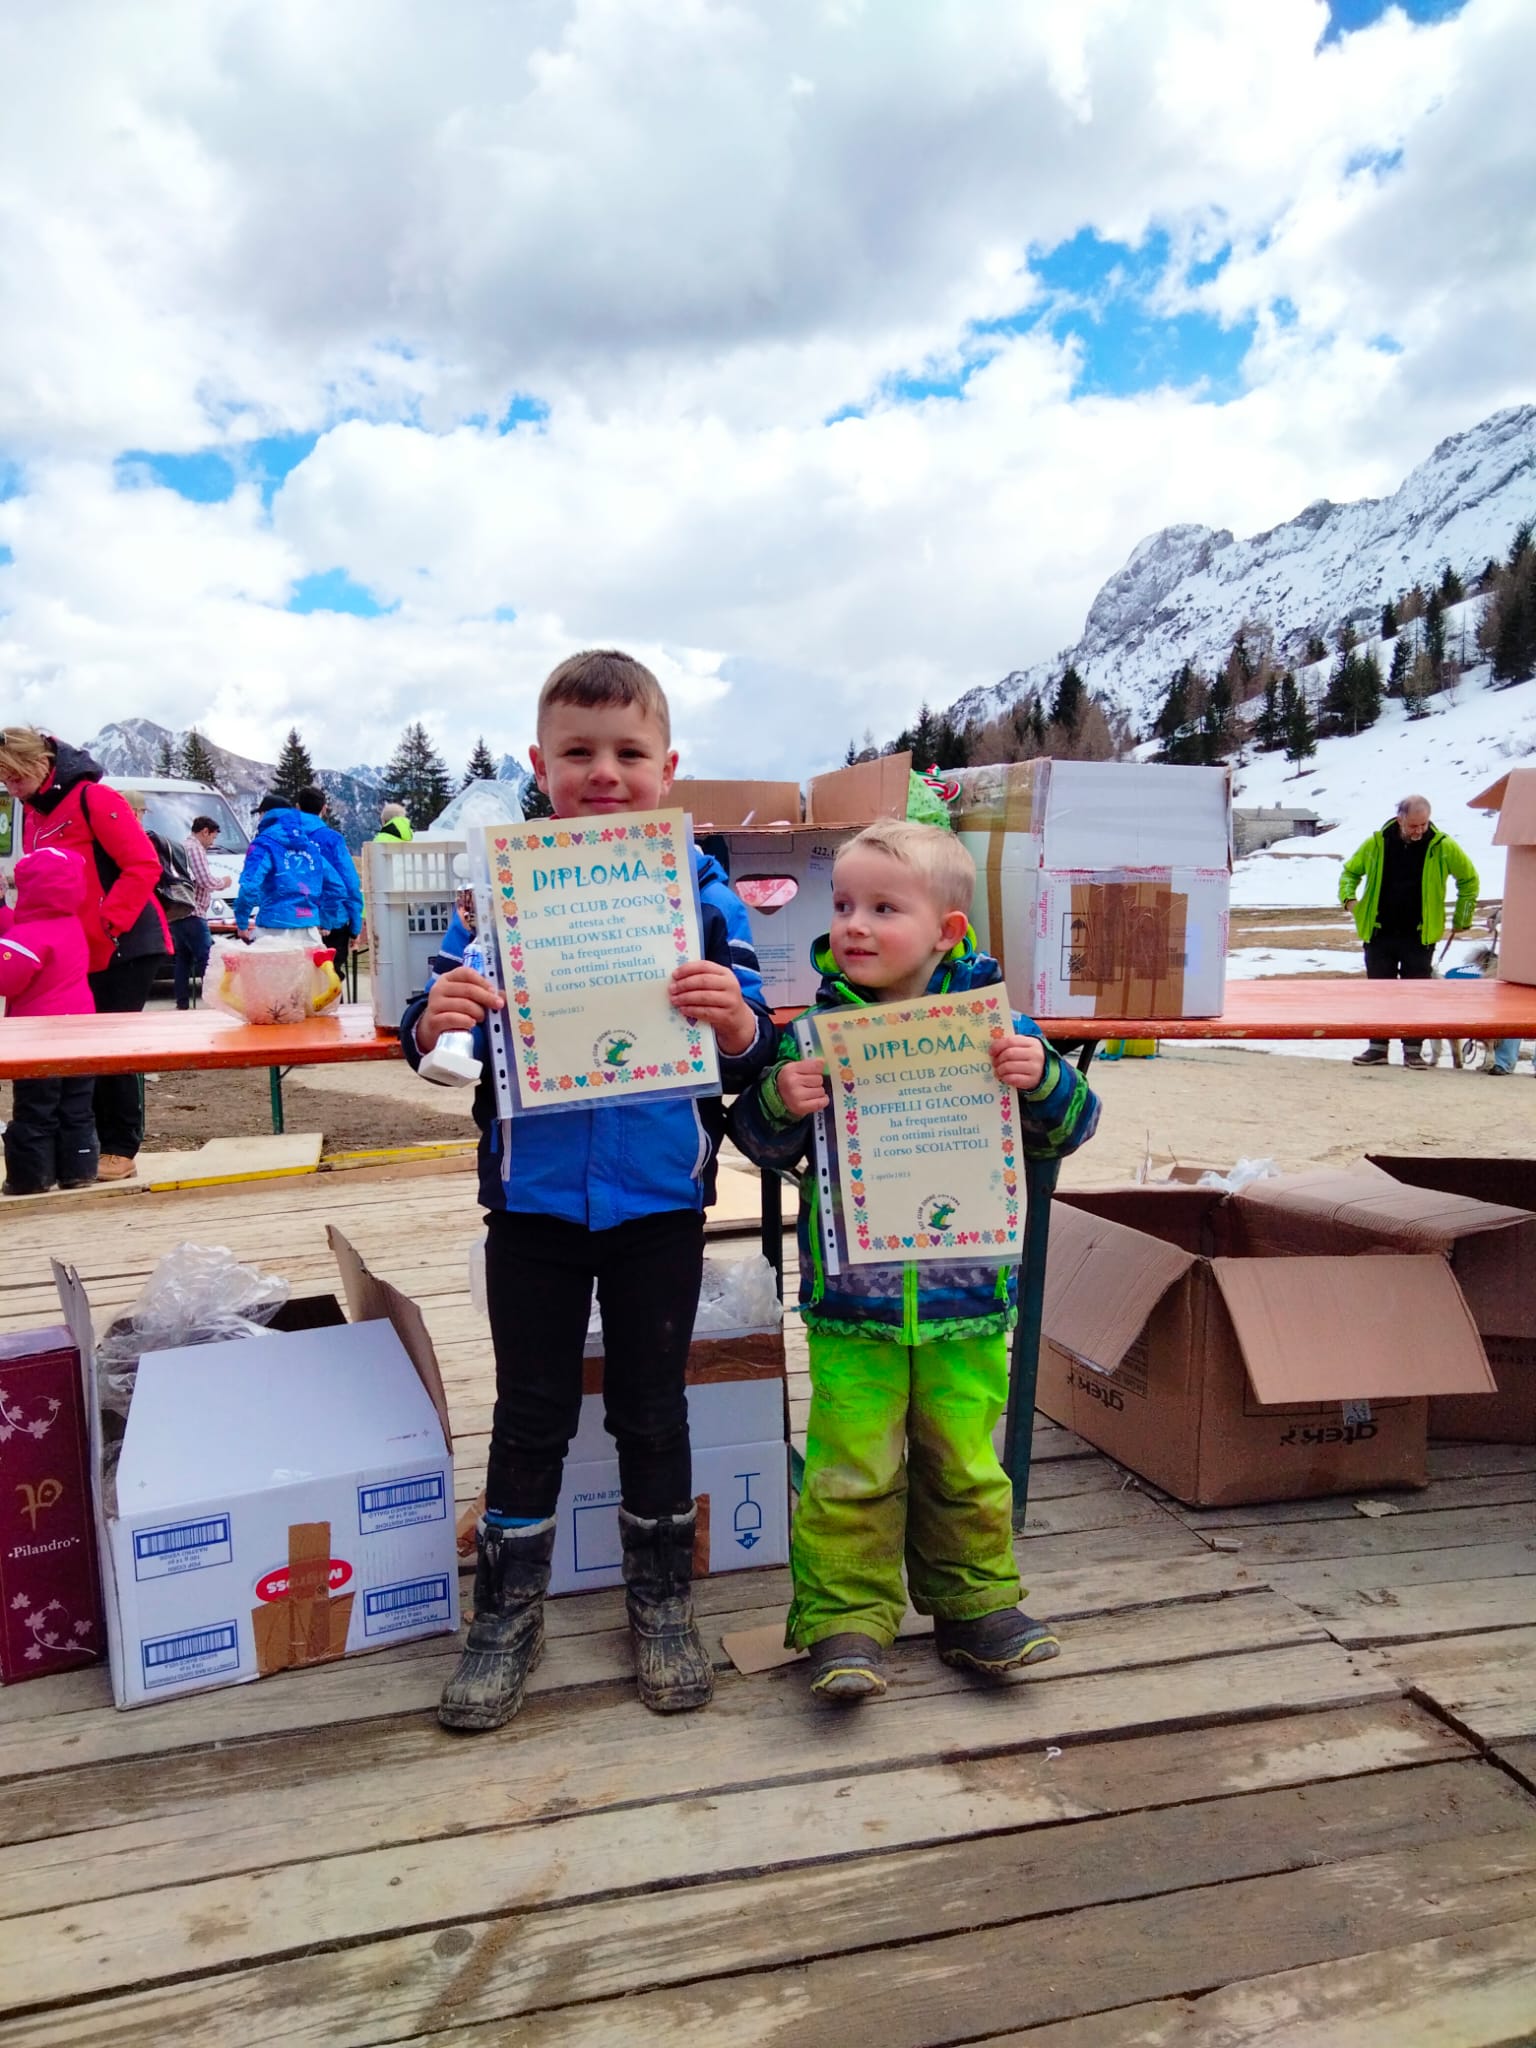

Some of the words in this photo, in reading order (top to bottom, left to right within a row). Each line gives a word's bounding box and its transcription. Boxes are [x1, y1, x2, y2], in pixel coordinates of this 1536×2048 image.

[533, 859, 650, 892] DIPLOMA
[523, 910, 538, 920] Lo
[543, 904, 566, 918] SCI
[570, 900, 608, 914] CLUB
[612, 893, 666, 910] ZOGNO
[568, 917, 604, 930] attesta
[607, 915, 626, 926] che
[524, 929, 623, 950] CHMIELOWSKI
[625, 923, 673, 938] CESARE
[560, 951, 574, 961] ha
[577, 944, 642, 960] frequentato
[551, 967, 571, 977] con
[574, 960, 609, 974] ottimi
[612, 954, 656, 970] risultati
[544, 982, 553, 993] il
[555, 980, 586, 992] corso
[589, 968, 666, 988] SCOIATTOLI
[863, 1033, 976, 1061] DIPLOMA
[857, 1077, 870, 1086] Lo
[875, 1072, 896, 1085] SCI
[900, 1068, 936, 1081] CLUB
[939, 1062, 992, 1077] ZOGNO
[898, 1085, 931, 1097] attesta
[934, 1082, 952, 1093] che
[861, 1100, 922, 1116] BOFFELLI
[925, 1093, 995, 1110] GIACOMO
[890, 1118, 902, 1128] ha
[905, 1113, 968, 1127] frequentato
[879, 1135, 899, 1143] con
[902, 1128, 935, 1141] ottimi
[938, 1124, 980, 1138] risultati
[873, 1148, 881, 1158] il
[884, 1146, 912, 1157] corso
[915, 1138, 989, 1154] SCOIATTOLI
[573, 1490, 596, 1503] ITALY
